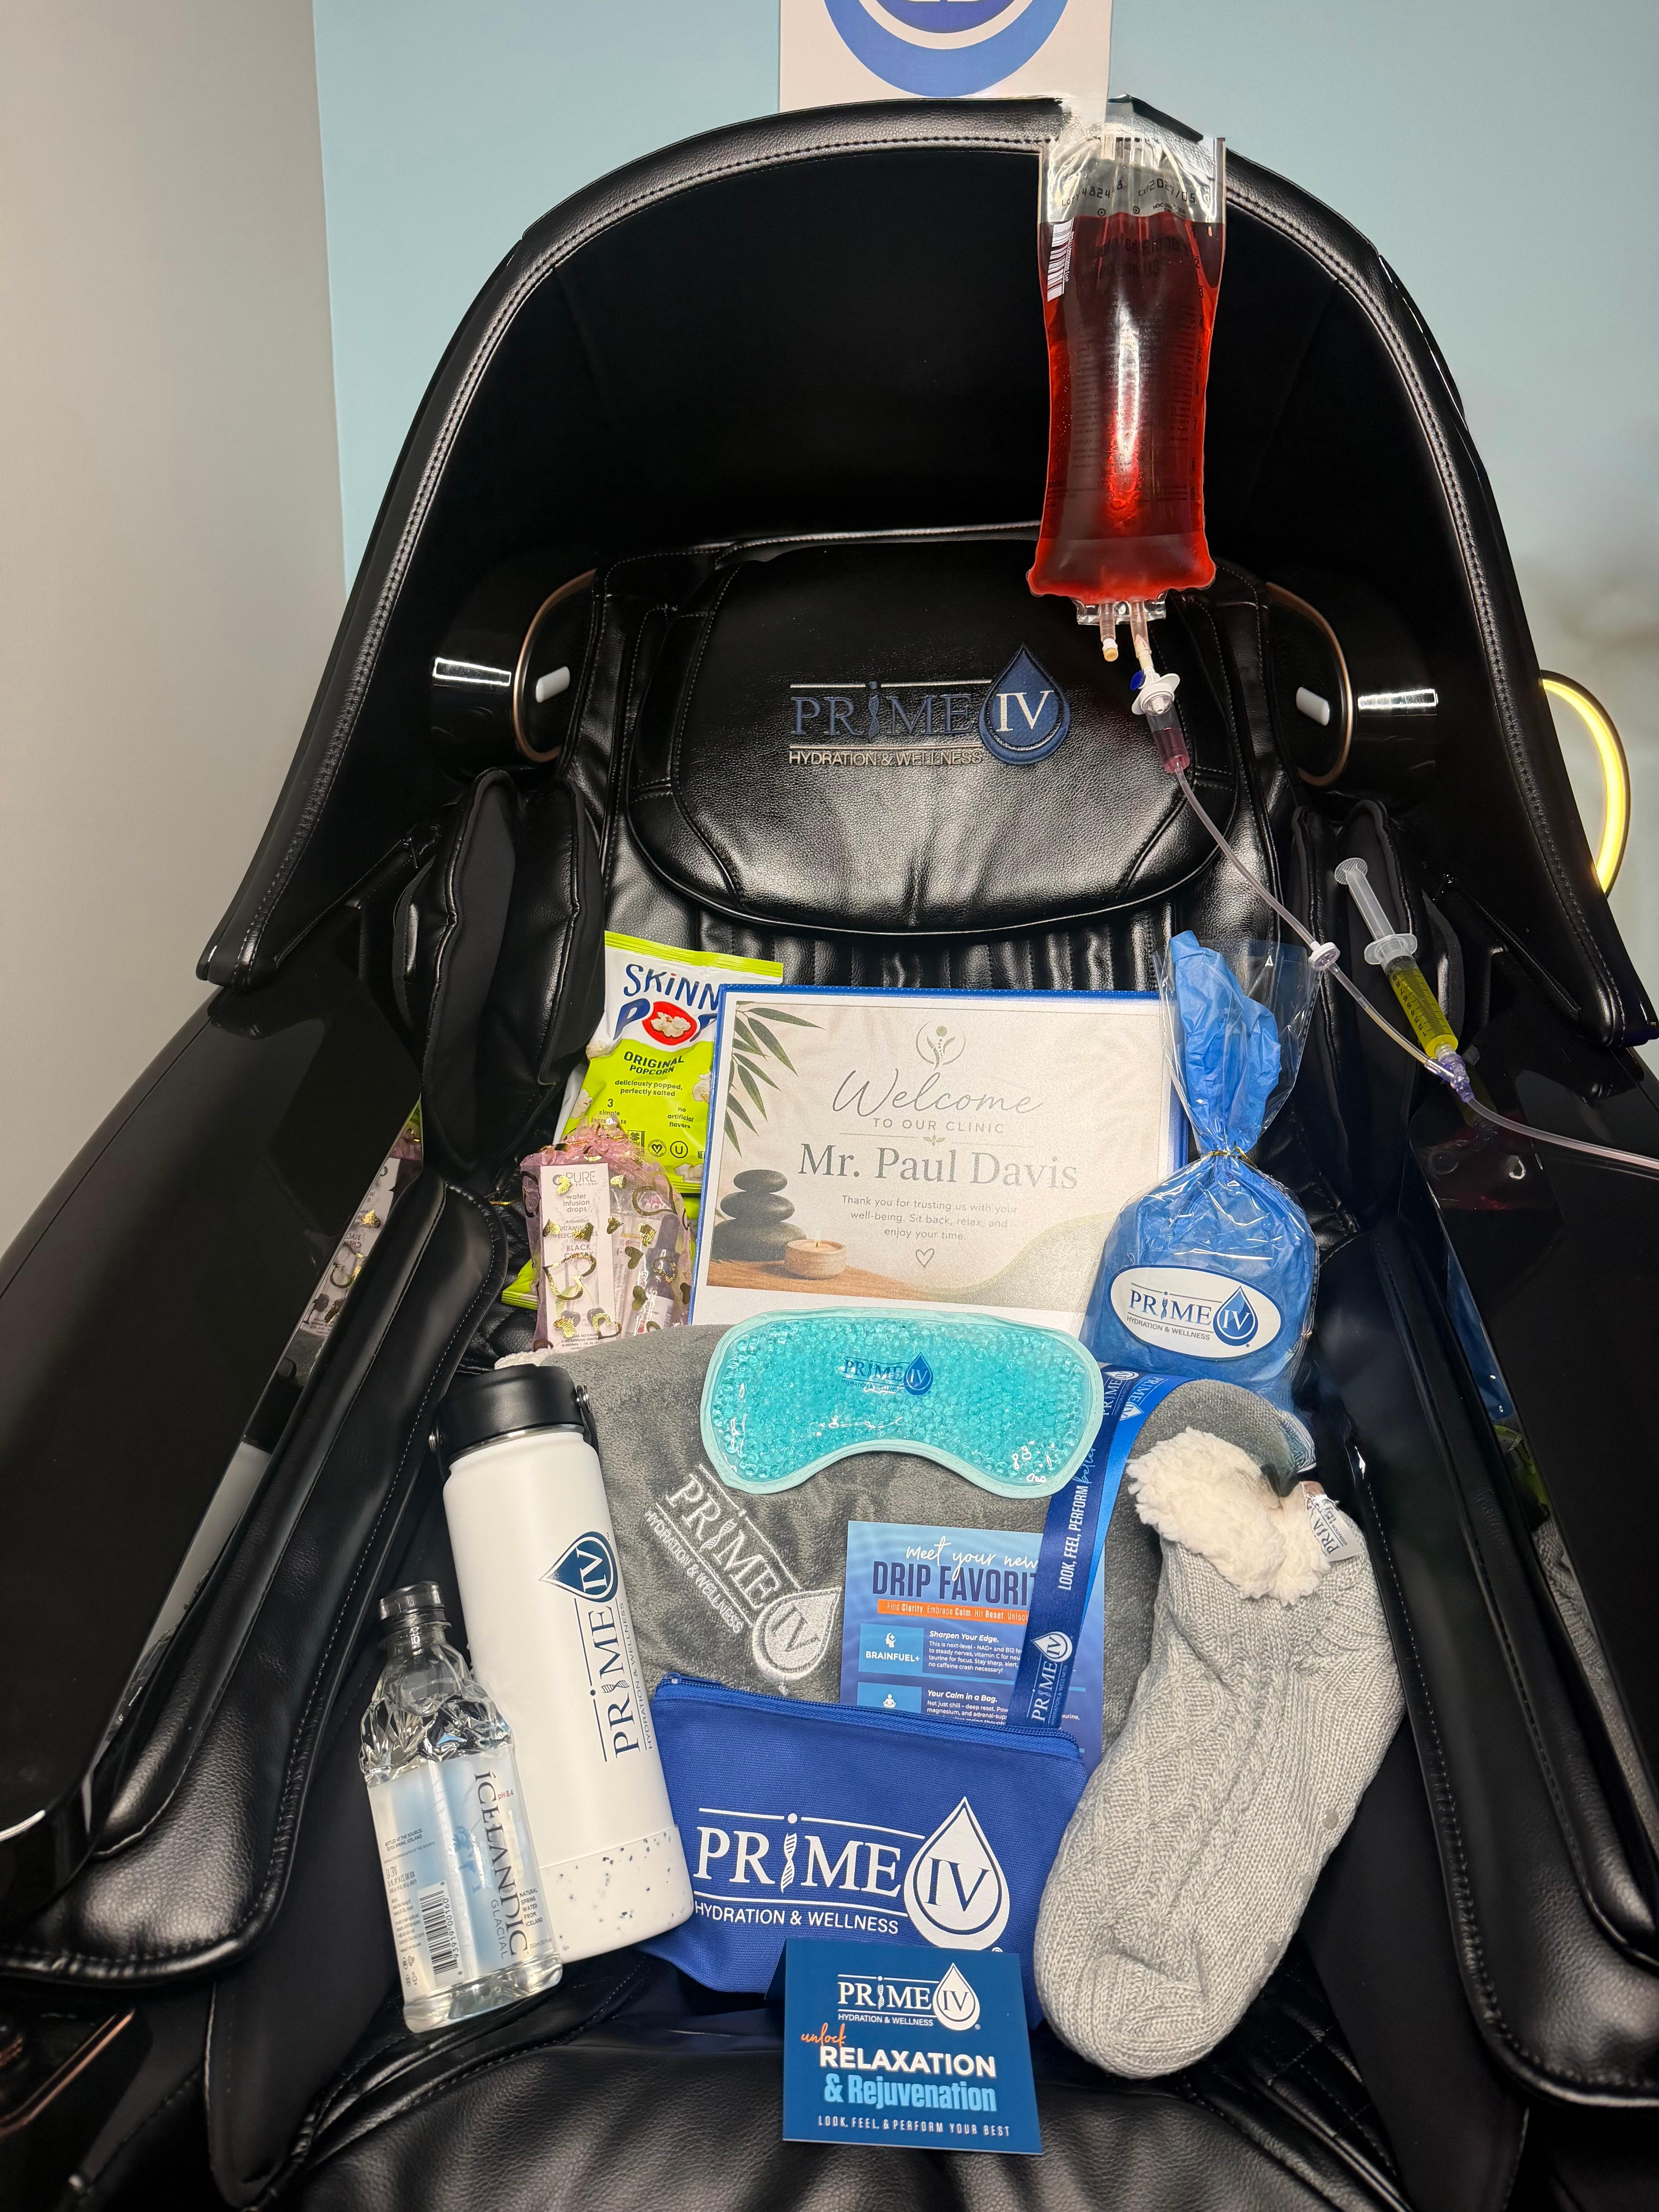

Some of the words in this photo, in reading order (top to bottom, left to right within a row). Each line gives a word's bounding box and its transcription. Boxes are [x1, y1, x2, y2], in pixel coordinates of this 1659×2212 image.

[996, 690, 1054, 732] IV
[789, 751, 878, 766] HYDRATION
[881, 752, 893, 765] &
[895, 750, 982, 765] WELLNESS
[623, 963, 721, 1011] SKiNN
[623, 1051, 684, 1068] ORIGINAL
[629, 1064, 675, 1075] POPCORN
[615, 1079, 652, 1089] deliciously
[653, 1082, 683, 1091] popped,
[620, 1087, 651, 1096] perfectly
[831, 1068, 1045, 1117] Welcome
[607, 1098, 613, 1108] 3
[873, 1117, 893, 1128] TO
[902, 1119, 936, 1130] OUR
[946, 1121, 1004, 1133] CLINIC
[797, 1143, 860, 1178] Mr.
[874, 1146, 957, 1183] Paul
[970, 1151, 1078, 1190] Davis
[842, 1195, 872, 1206] Thank
[874, 1198, 893, 1208] you
[896, 1197, 910, 1207] for
[913, 1199, 951, 1212] trusting
[955, 1202, 966, 1211] us
[970, 1202, 992, 1212] with
[995, 1205, 1017, 1215] your
[850, 1210, 905, 1223] well-being.
[909, 1214, 922, 1223] Sit
[925, 1214, 953, 1226] back,
[988, 1218, 1008, 1228] and
[884, 1228, 912, 1240] enjoy
[915, 1230, 938, 1240] your
[941, 1230, 967, 1240] time.
[1129, 1291, 1212, 1326] PRIME
[1222, 1309, 1251, 1330] IV
[1127, 1316, 1162, 1330] HYDRATION
[1172, 1327, 1210, 1340] WELLNESS
[910, 1369, 928, 1383] IV
[1068, 1485, 1089, 1532] PERFORM
[1064, 1534, 1082, 1558] FEEL,
[666, 1473, 781, 1610] PRIME
[771, 1606, 821, 1652] IV
[906, 1535, 951, 1566] meet
[951, 1552, 997, 1581] your
[1004, 1553, 1039, 1568] new
[575, 1547, 608, 1592] IV
[644, 1510, 695, 1570] HYDRATION
[686, 1564, 699, 1577] &
[695, 1573, 744, 1633] WELLNESS
[1058, 1560, 1077, 1590] LOOK,
[872, 1561, 931, 1597] DRIP
[939, 1566, 1036, 1606] FAVORI
[887, 1602, 900, 1611] Find
[927, 1605, 953, 1615] Embrace
[975, 1609, 983, 1618] Hit
[620, 1602, 635, 1664] WELLNESS
[929, 1630, 959, 1640] Sharpen
[979, 1635, 999, 1643] Edge.
[866, 1651, 920, 1662] BRAINFUEL+
[1046, 1635, 1061, 1656] IV
[587, 1606, 641, 1759] PRIME
[945, 1691, 964, 1699] Calm
[981, 1695, 998, 1703] Bag.
[634, 1681, 653, 1749] HYDRATION
[498, 1792, 506, 1800] pH
[694, 1814, 902, 1898] PRIME
[926, 1857, 992, 1911] IV
[520, 1887, 538, 1898] NATURAL
[521, 1896, 536, 1905] SPRING
[522, 1903, 538, 1912] WATER
[524, 1911, 536, 1920] FROM
[694, 1900, 785, 1925] HYDRATION
[790, 1911, 802, 1925] &
[808, 1911, 899, 1934] WELLNESS
[491, 1899, 508, 1959] GLACIAL
[526, 1917, 543, 1927] ICELAND
[838, 1977, 932, 2010] PRIME
[941, 1990, 969, 2011] IV
[838, 2014, 883, 2023] HYDRATION
[892, 2017, 933, 2027] WELLNESS
[800, 2022, 846, 2046] unlock
[819, 2046, 996, 2078] RELAXATION
[824, 2073, 844, 2103] &
[848, 2075, 997, 2111] Rejuvenation
[818, 2116, 848, 2128] LOOK,
[852, 2118, 879, 2130] FEEL,
[883, 2119, 889, 2130] &
[893, 2120, 943, 2133] PERFORM
[950, 2123, 977, 2135] YOUR
[984, 2125, 1010, 2137] BEST
